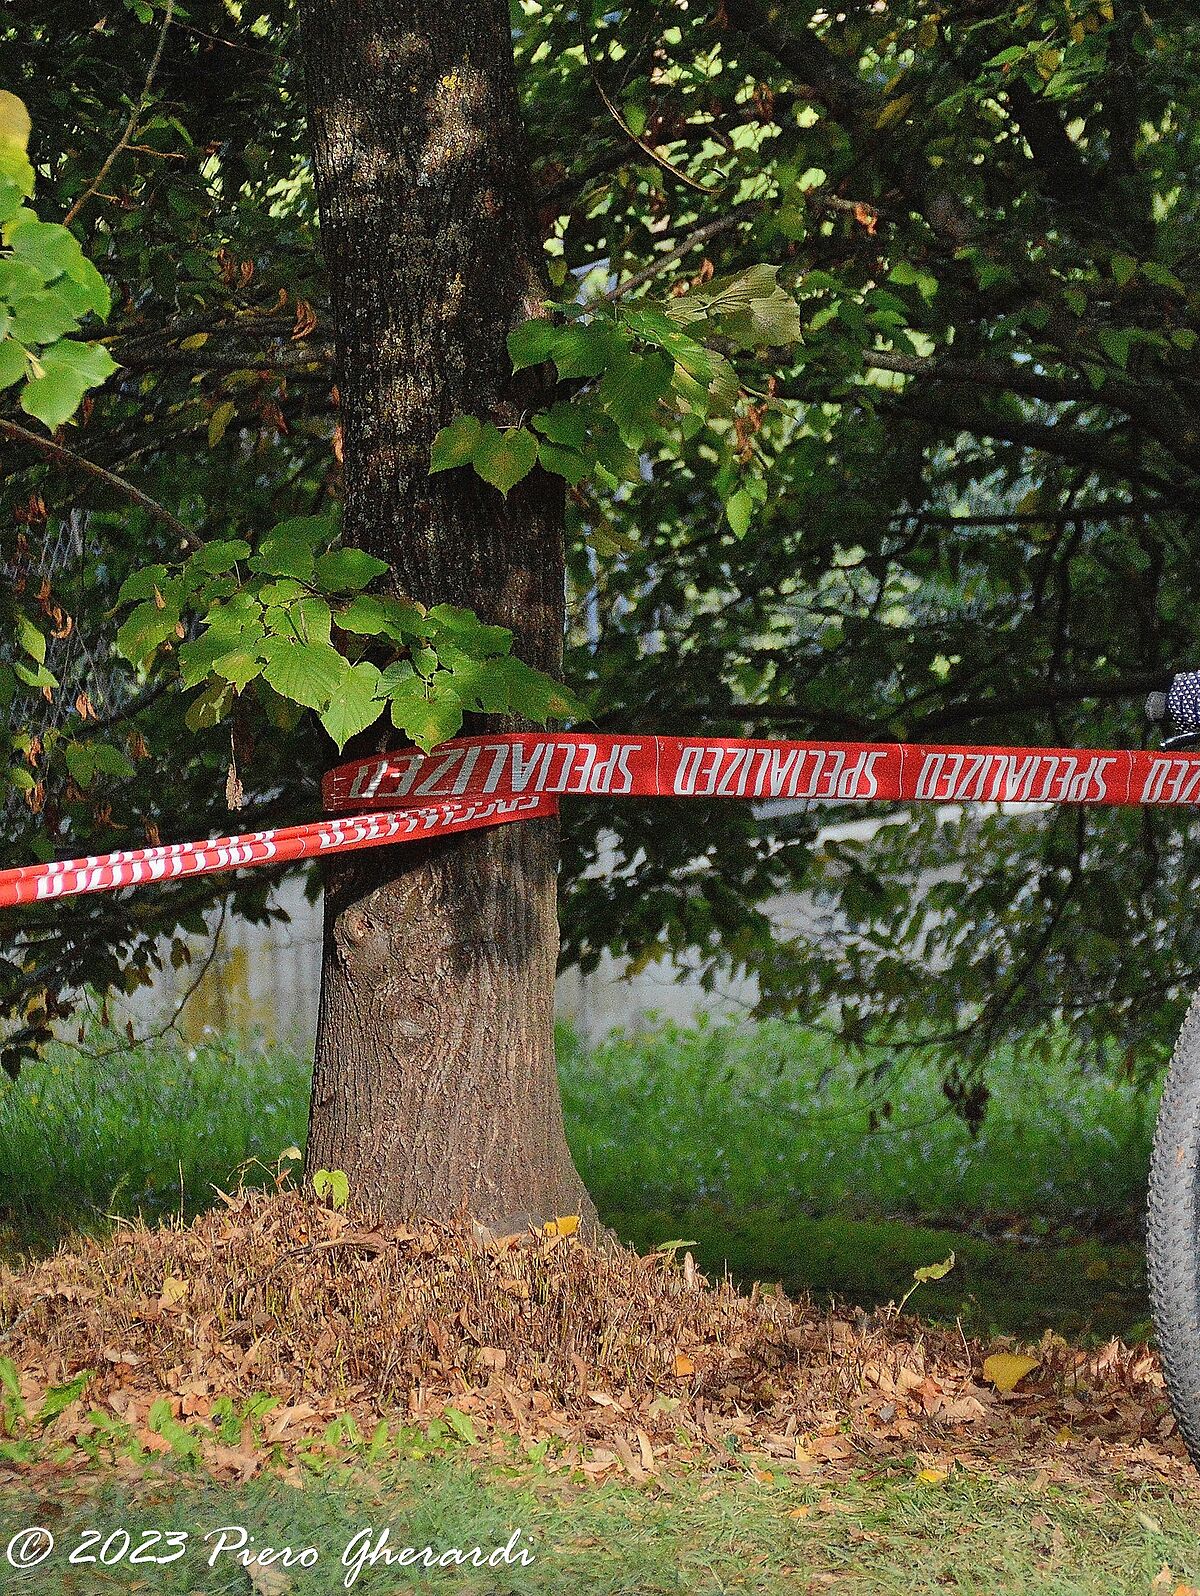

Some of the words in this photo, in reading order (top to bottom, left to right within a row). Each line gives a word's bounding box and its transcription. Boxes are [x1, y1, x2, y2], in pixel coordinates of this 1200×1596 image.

[349, 743, 641, 798] SPECIALIZED
[673, 747, 887, 798] SPECIALIZED
[915, 753, 1116, 801] SPECIALIZED
